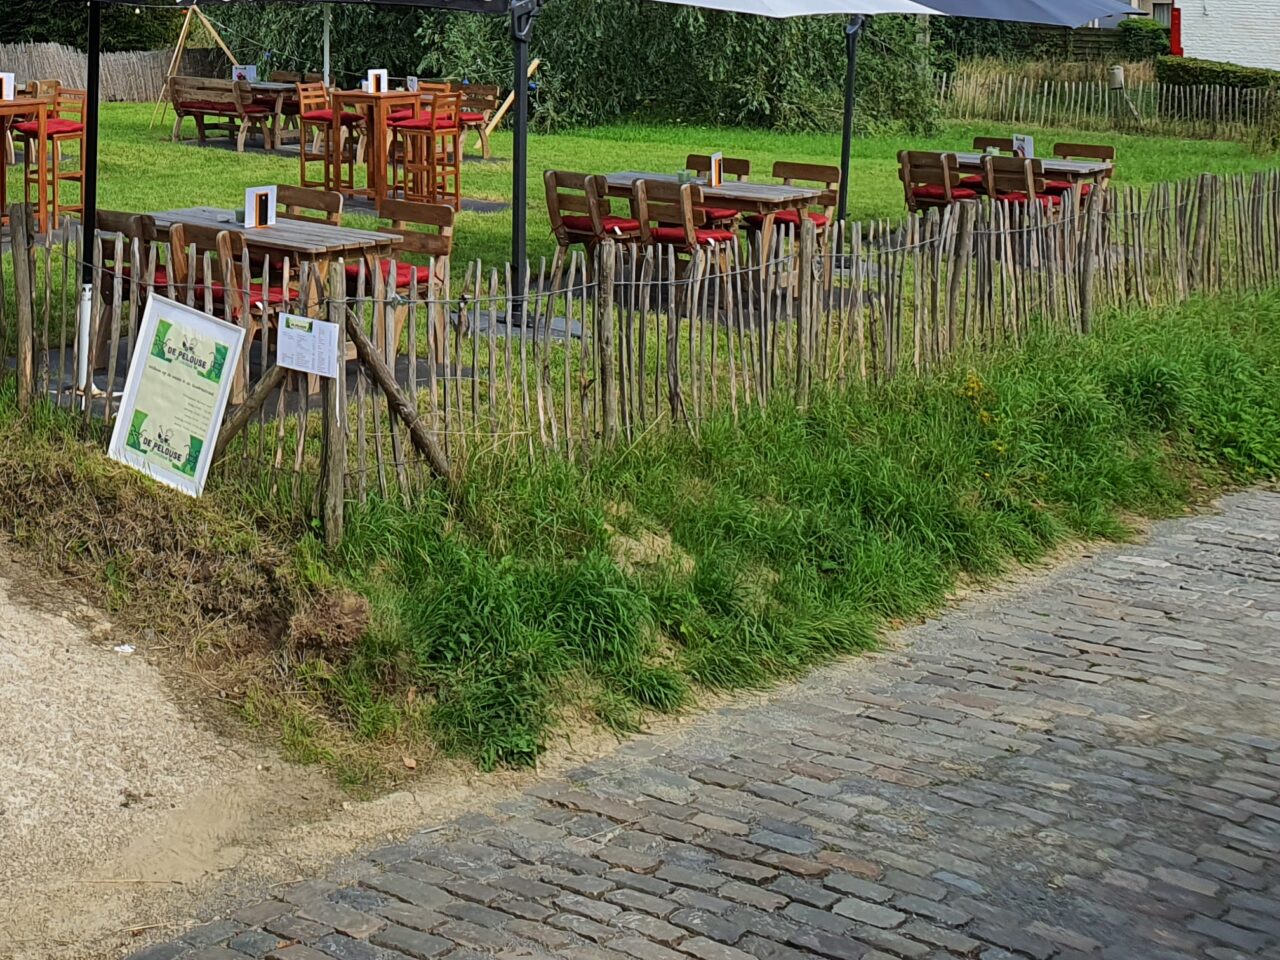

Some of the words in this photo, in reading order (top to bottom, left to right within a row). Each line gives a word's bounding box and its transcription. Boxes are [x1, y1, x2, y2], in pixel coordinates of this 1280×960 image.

[167, 346, 177, 356] DE
[175, 350, 207, 369] PELOUSE
[142, 437, 152, 447] DE
[150, 442, 182, 462] PELOUSE
